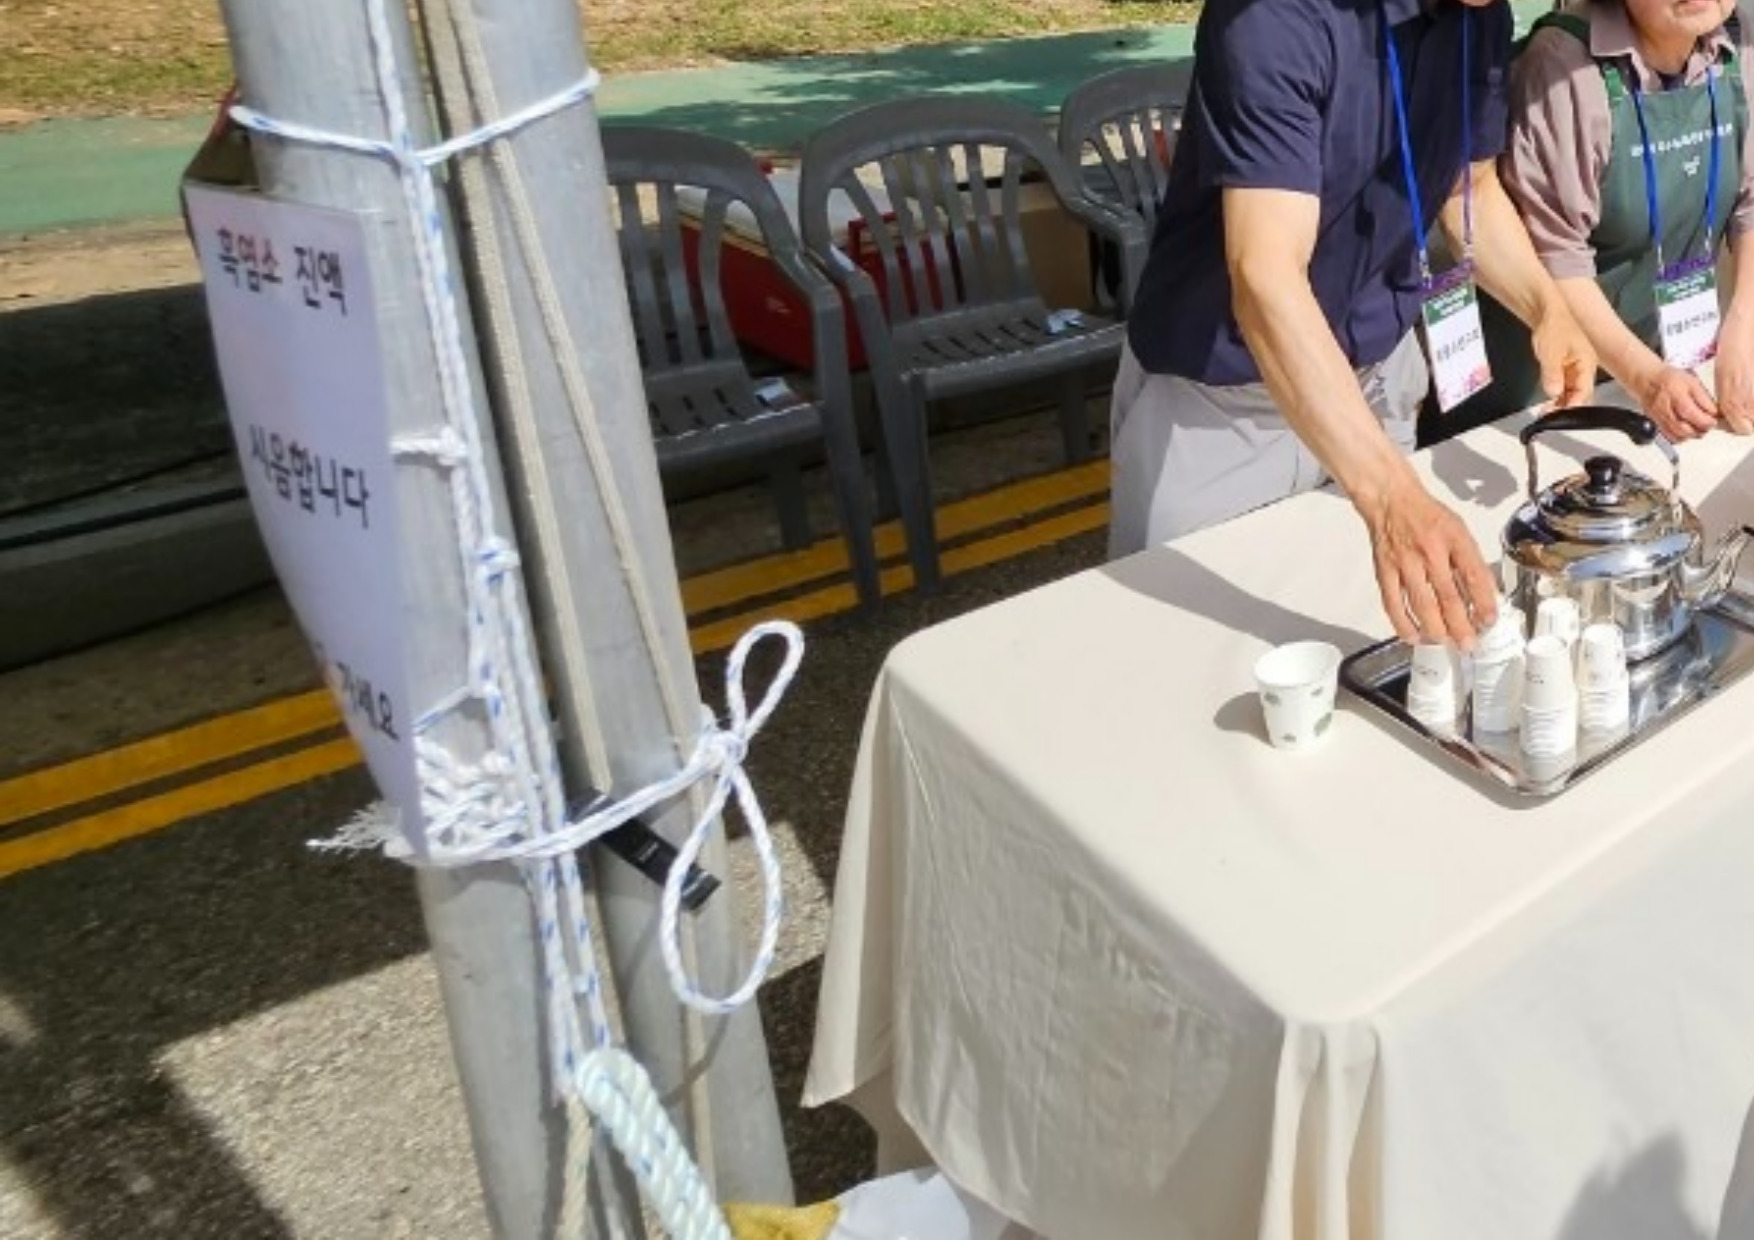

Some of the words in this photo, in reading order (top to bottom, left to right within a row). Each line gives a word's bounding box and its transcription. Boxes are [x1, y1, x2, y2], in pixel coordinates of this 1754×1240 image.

[217, 227, 283, 293] 흑염소
[293, 245, 348, 316] 진액
[250, 423, 370, 529] 시음합니다
